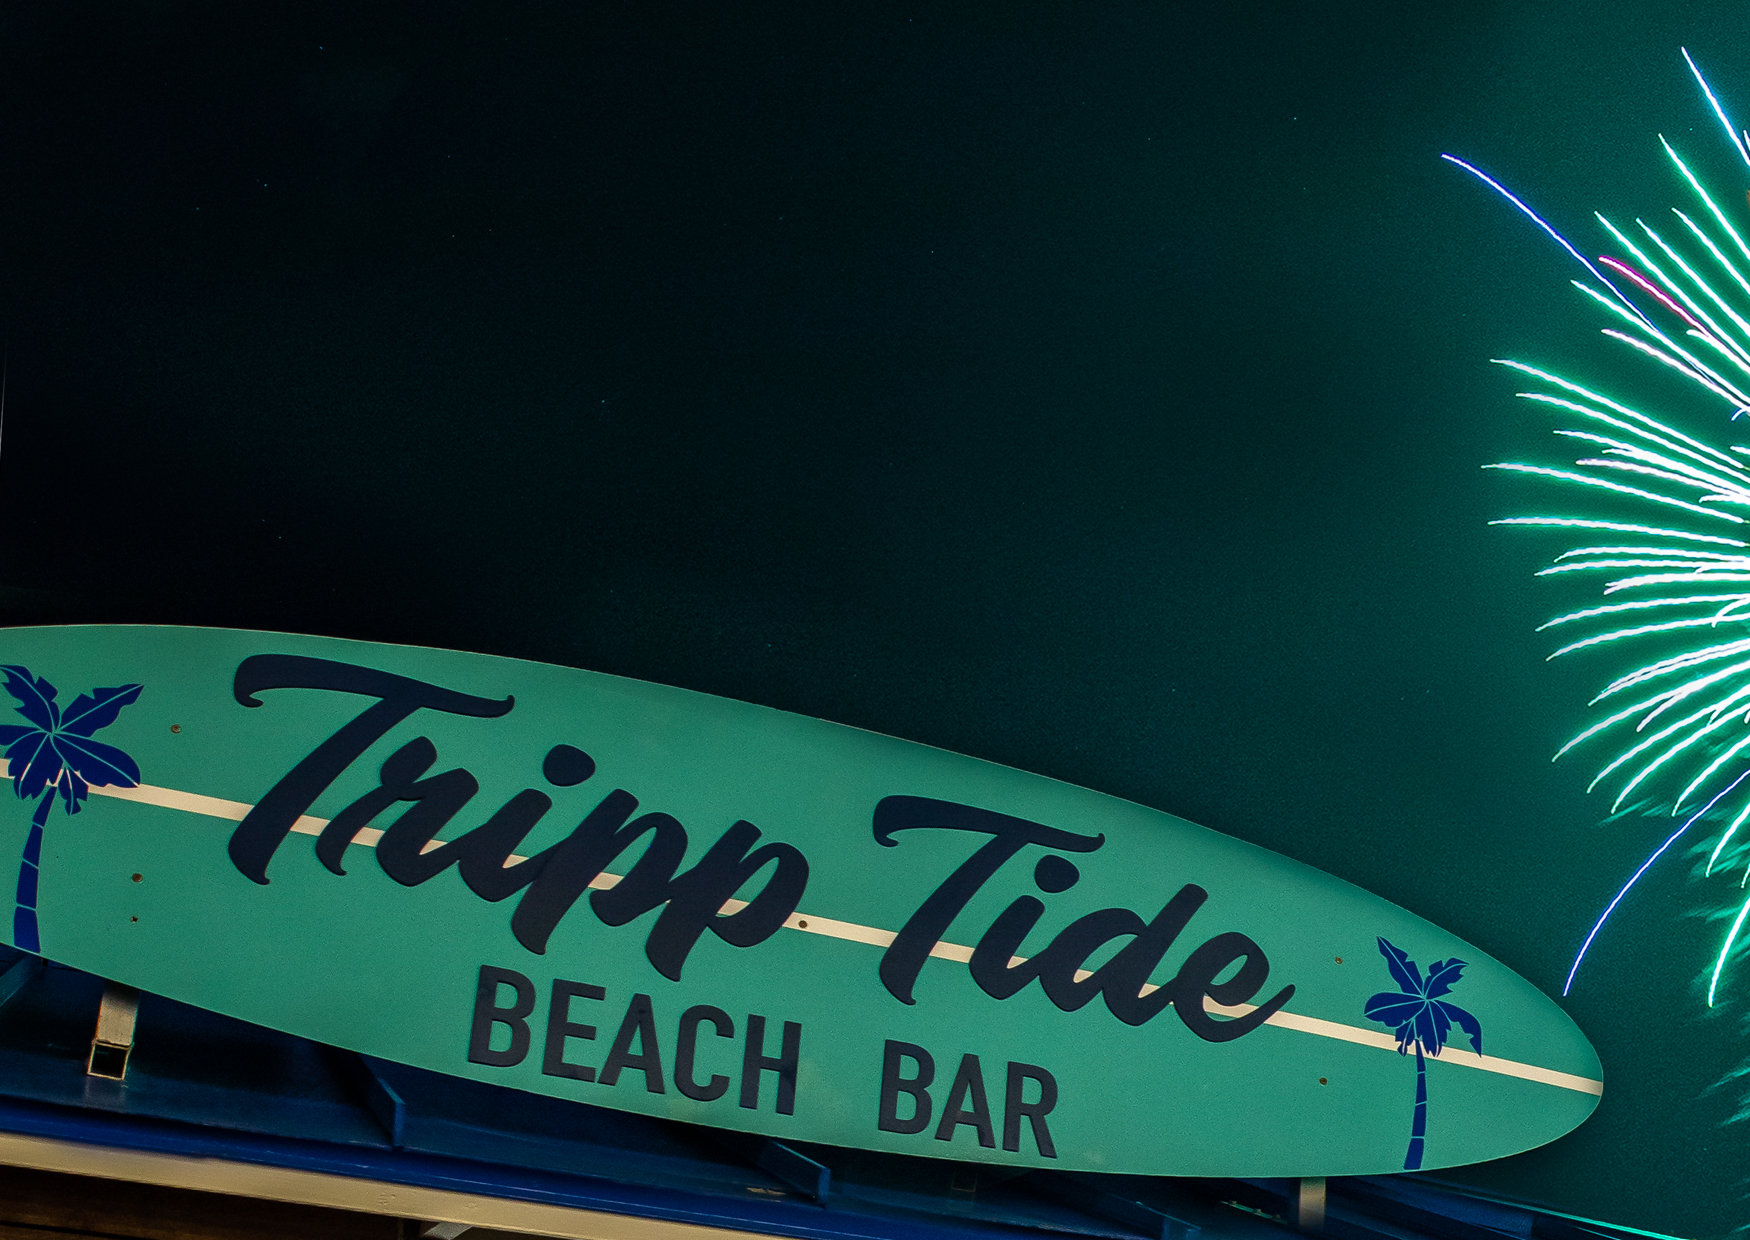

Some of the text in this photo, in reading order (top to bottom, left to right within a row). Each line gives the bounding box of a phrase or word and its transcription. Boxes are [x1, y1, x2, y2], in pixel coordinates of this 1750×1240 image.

[227, 654, 1297, 1043] Tripp Tide
[468, 965, 1059, 1159] BEACH BAR
